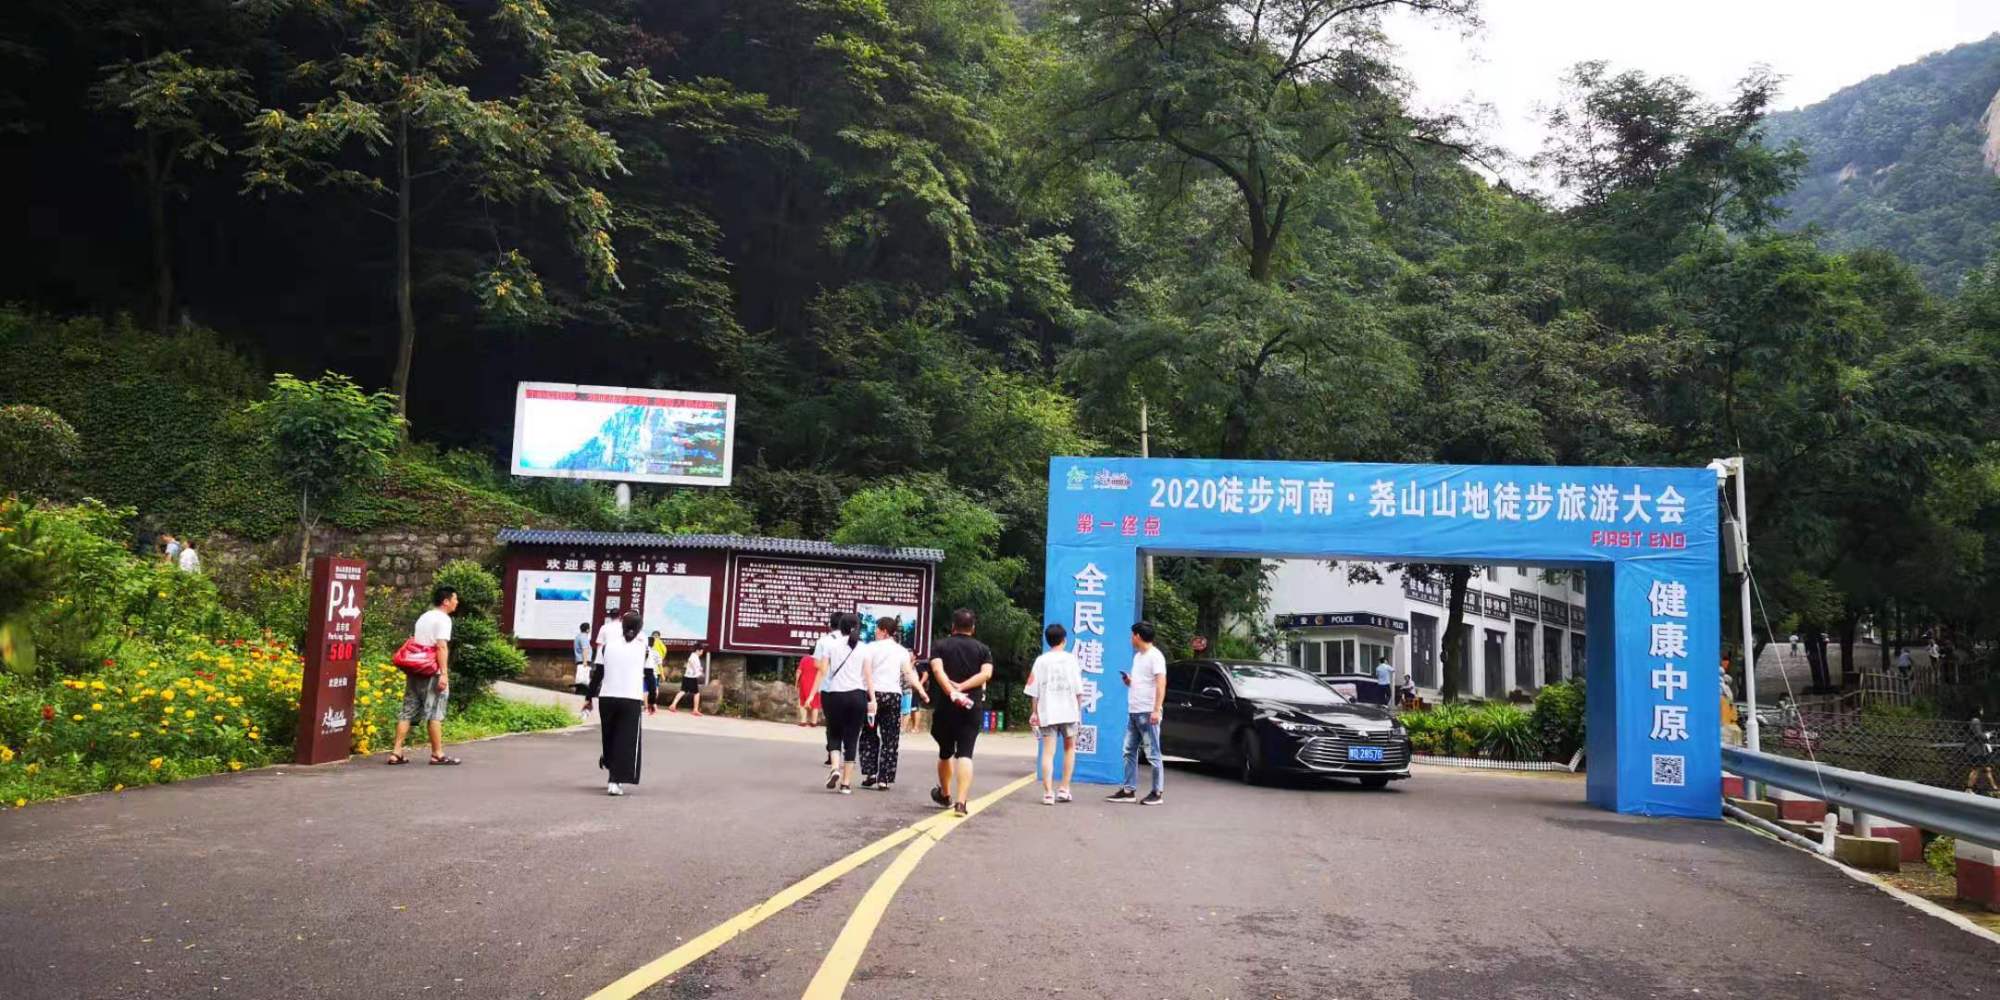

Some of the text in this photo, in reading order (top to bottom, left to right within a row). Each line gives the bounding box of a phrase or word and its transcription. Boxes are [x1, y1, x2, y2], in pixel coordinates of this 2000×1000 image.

[1076, 512, 1161, 537] 第一终点
[1591, 530, 1686, 549] FIRST END
[546, 558, 688, 575] 欢迎乘坐尧山索道
[328, 580, 344, 622] P
[1331, 615, 1355, 624] POLICE
[1072, 562, 1107, 713] 全民健身
[330, 642, 354, 661] 500
[1648, 579, 1690, 742] 健康中原
